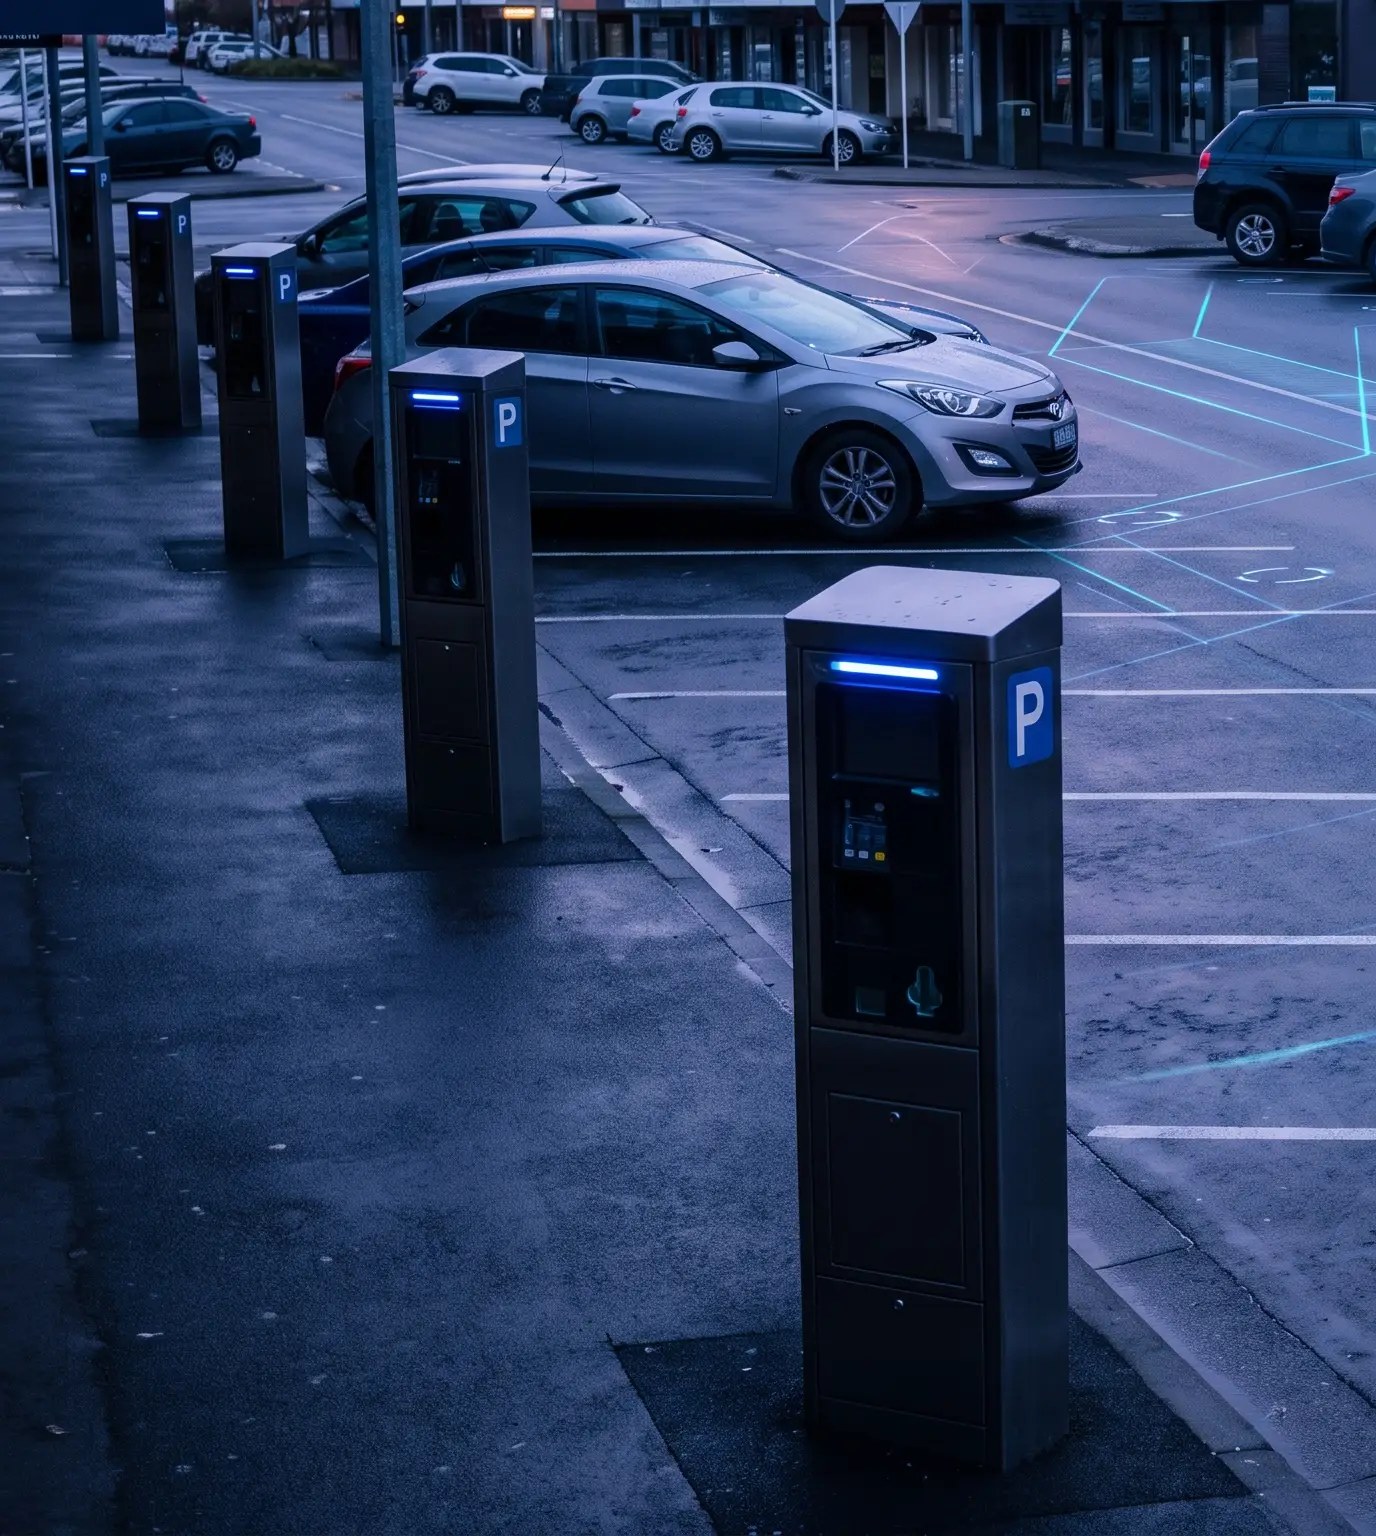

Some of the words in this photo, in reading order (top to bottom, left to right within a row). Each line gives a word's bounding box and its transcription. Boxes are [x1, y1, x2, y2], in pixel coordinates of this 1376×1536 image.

[100, 172, 108, 188] P
[178, 214, 187, 234] P
[279, 274, 291, 300] P
[498, 402, 517, 443] P
[1015, 680, 1045, 757] P
